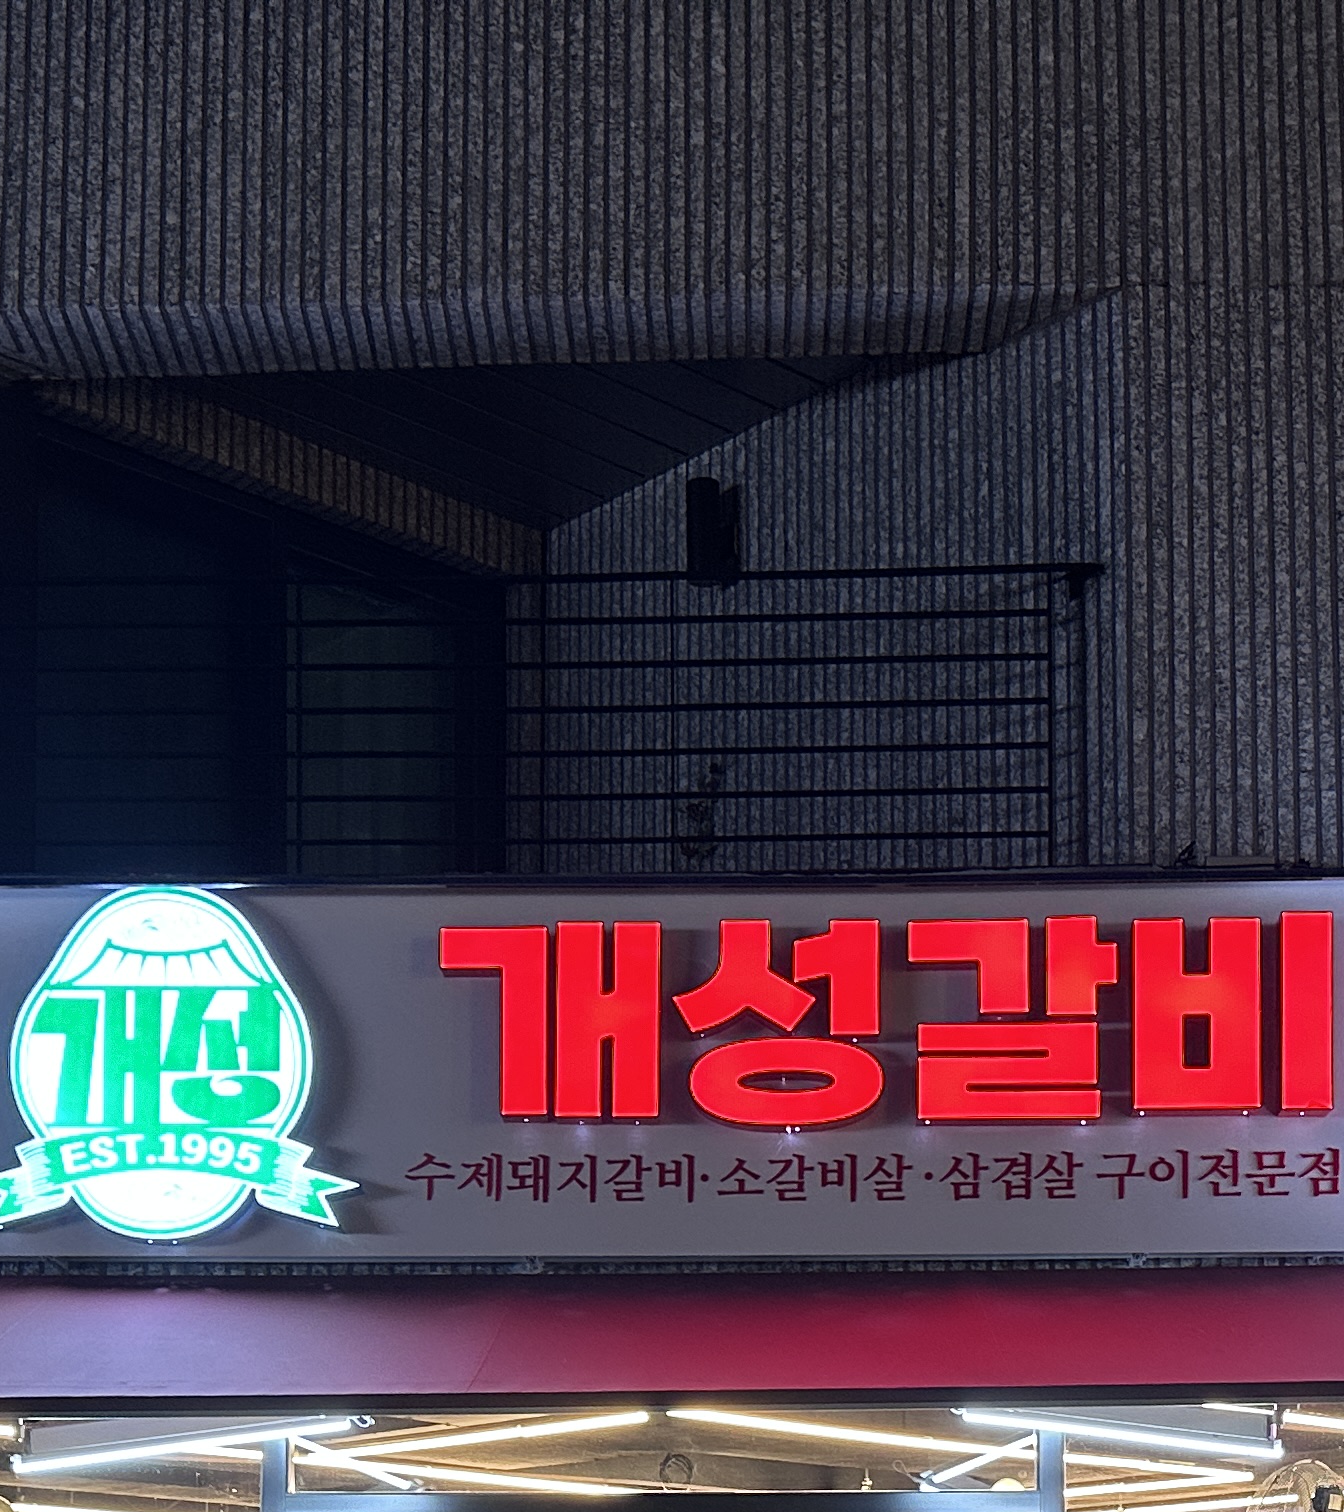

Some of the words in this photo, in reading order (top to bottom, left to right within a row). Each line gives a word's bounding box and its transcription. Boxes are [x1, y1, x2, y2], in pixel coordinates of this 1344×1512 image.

[31, 985, 281, 1129] 개성
[438, 909, 1334, 1130] 개성갈비
[58, 1132, 263, 1175] EST.1995
[1096, 1147, 1342, 1199] 구이전문점
